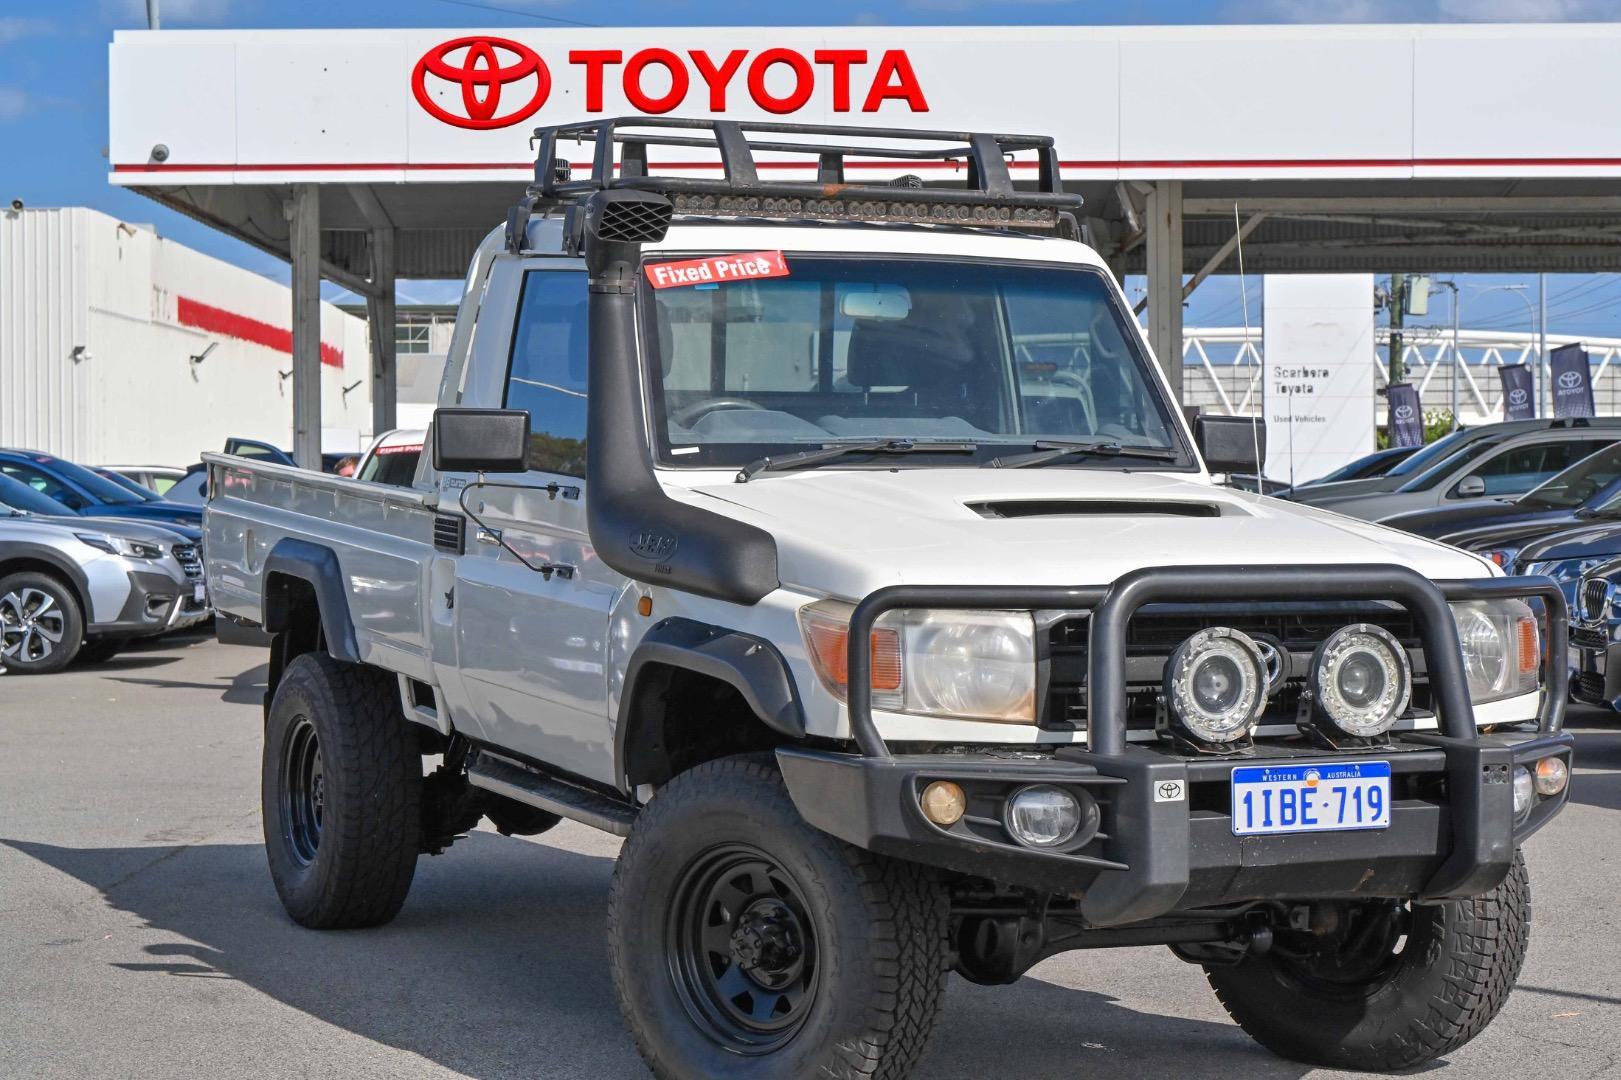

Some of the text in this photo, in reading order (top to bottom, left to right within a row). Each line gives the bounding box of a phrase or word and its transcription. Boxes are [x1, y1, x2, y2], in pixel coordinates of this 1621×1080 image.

[569, 47, 930, 115] TOYOTA
[654, 262, 712, 285] Fixed
[714, 257, 771, 279] Price
[1274, 381, 1314, 397] Toyota
[1262, 770, 1362, 782] WESTERN AUSTRALIA
